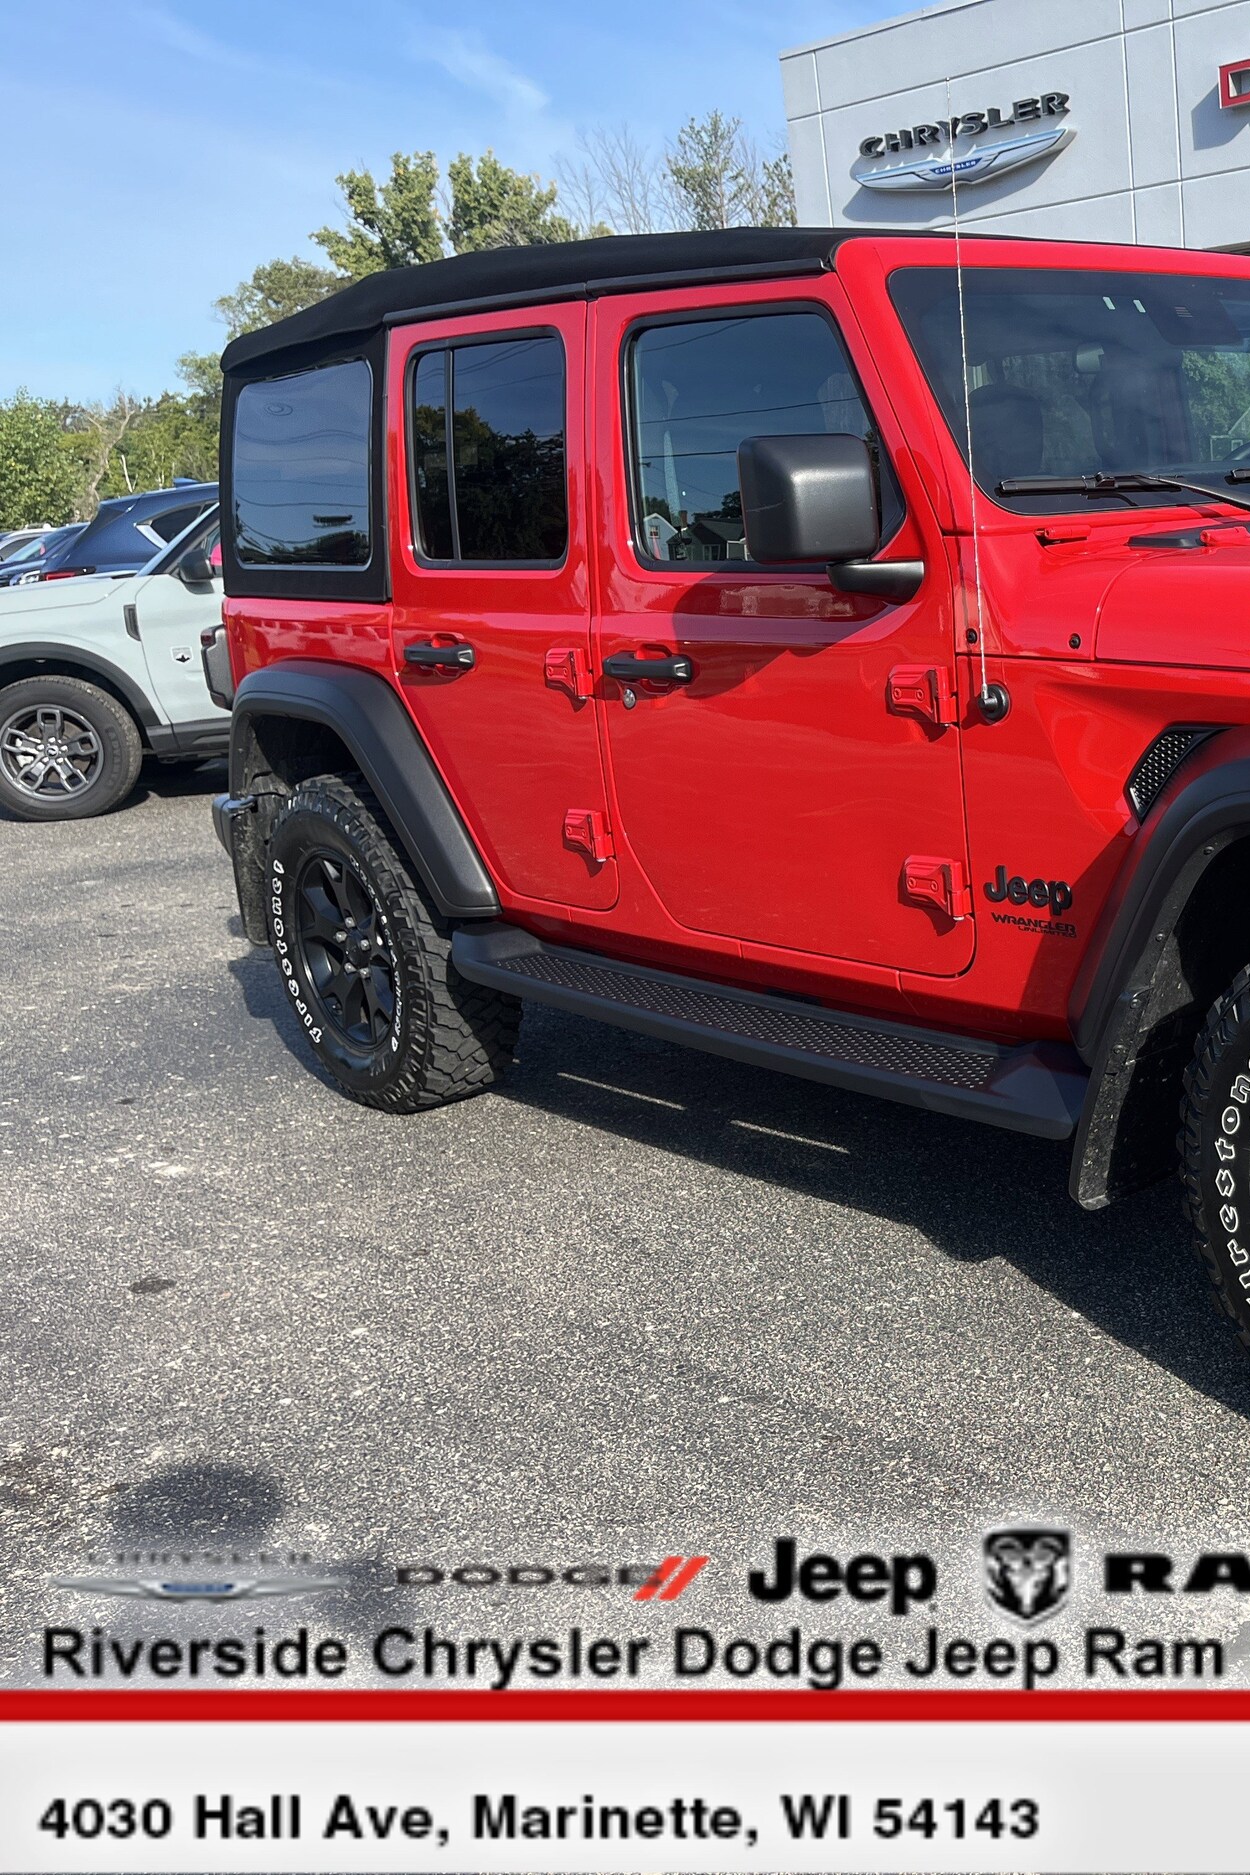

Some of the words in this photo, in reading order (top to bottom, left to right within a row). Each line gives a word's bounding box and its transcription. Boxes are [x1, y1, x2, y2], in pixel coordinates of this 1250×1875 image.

[859, 91, 1070, 159] CHRYSLER
[934, 160, 977, 174] CHRSLER
[983, 864, 1072, 916] Jeep
[991, 911, 1076, 934] WRANGLER
